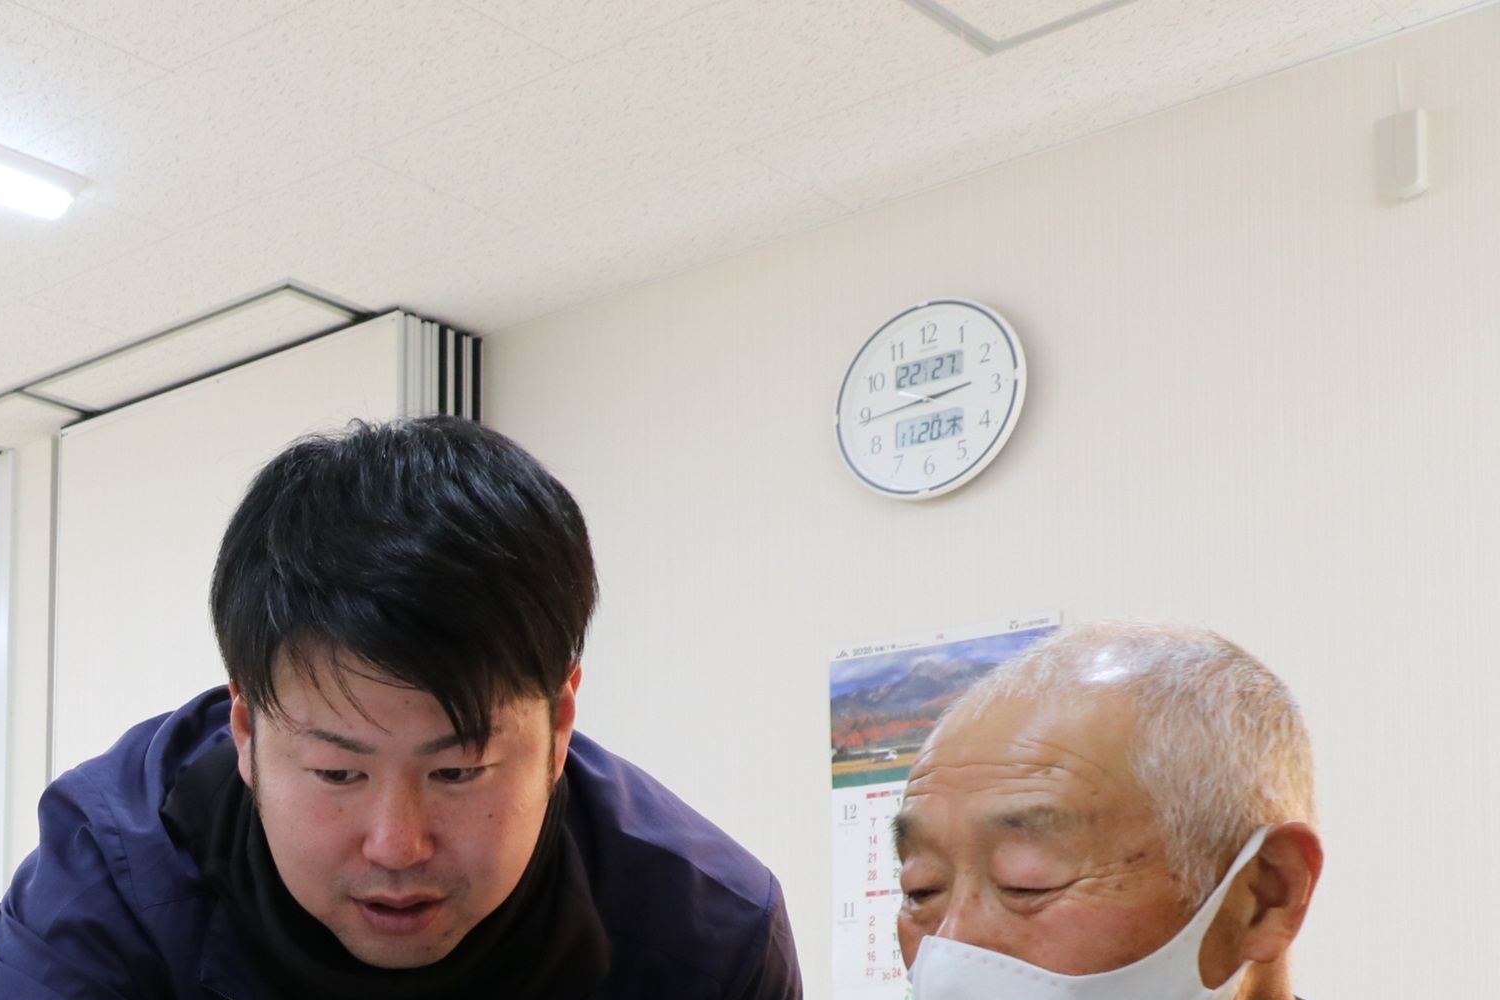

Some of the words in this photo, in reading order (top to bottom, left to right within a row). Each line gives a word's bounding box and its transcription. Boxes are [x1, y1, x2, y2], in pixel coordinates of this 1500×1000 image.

[920, 323, 938, 345] 12
[958, 324, 965, 344] 1
[890, 342, 905, 362] 11
[980, 342, 991, 364] 2
[867, 371, 885, 393] 10
[990, 372, 1002, 394] 3
[860, 406, 872, 427] 9
[979, 409, 991, 428] 4
[870, 435, 883, 455] 8
[956, 439, 968, 461] 5
[893, 455, 904, 475] 7
[923, 456, 936, 476] 6
[843, 804, 858, 820] 12
[870, 817, 877, 828] 7
[868, 834, 878, 846] 14
[868, 852, 877, 864] 21
[867, 869, 878, 881] 28
[843, 902, 855, 918] 11
[868, 916, 876, 927] 2
[868, 933, 876, 945] 9
[867, 950, 877, 963] 16
